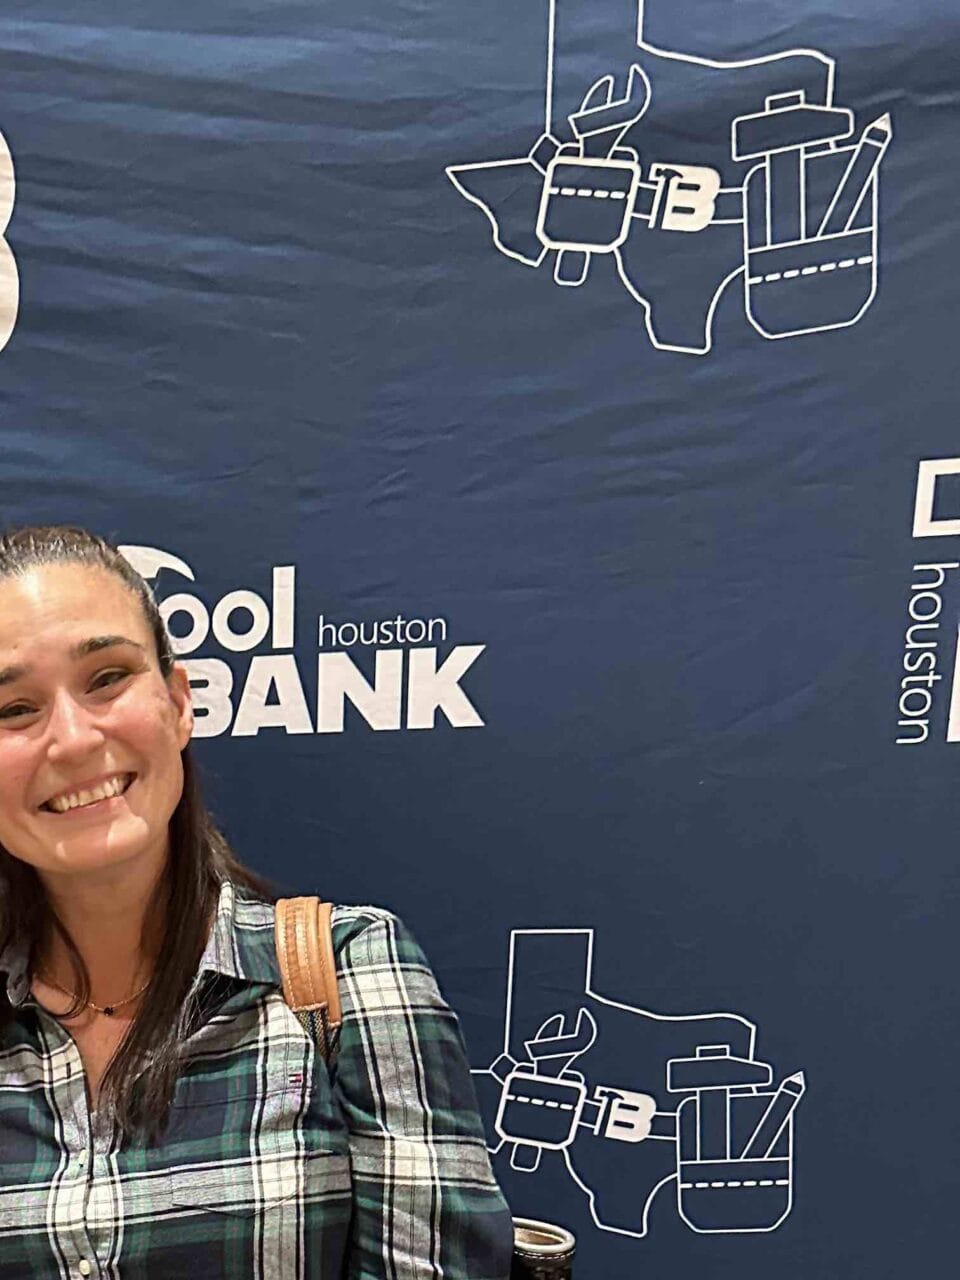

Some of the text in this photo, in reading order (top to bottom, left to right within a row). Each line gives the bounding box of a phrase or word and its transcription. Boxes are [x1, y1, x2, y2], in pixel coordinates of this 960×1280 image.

[116, 544, 296, 655] ool
[318, 615, 447, 647] houston
[895, 562, 960, 744] houston
